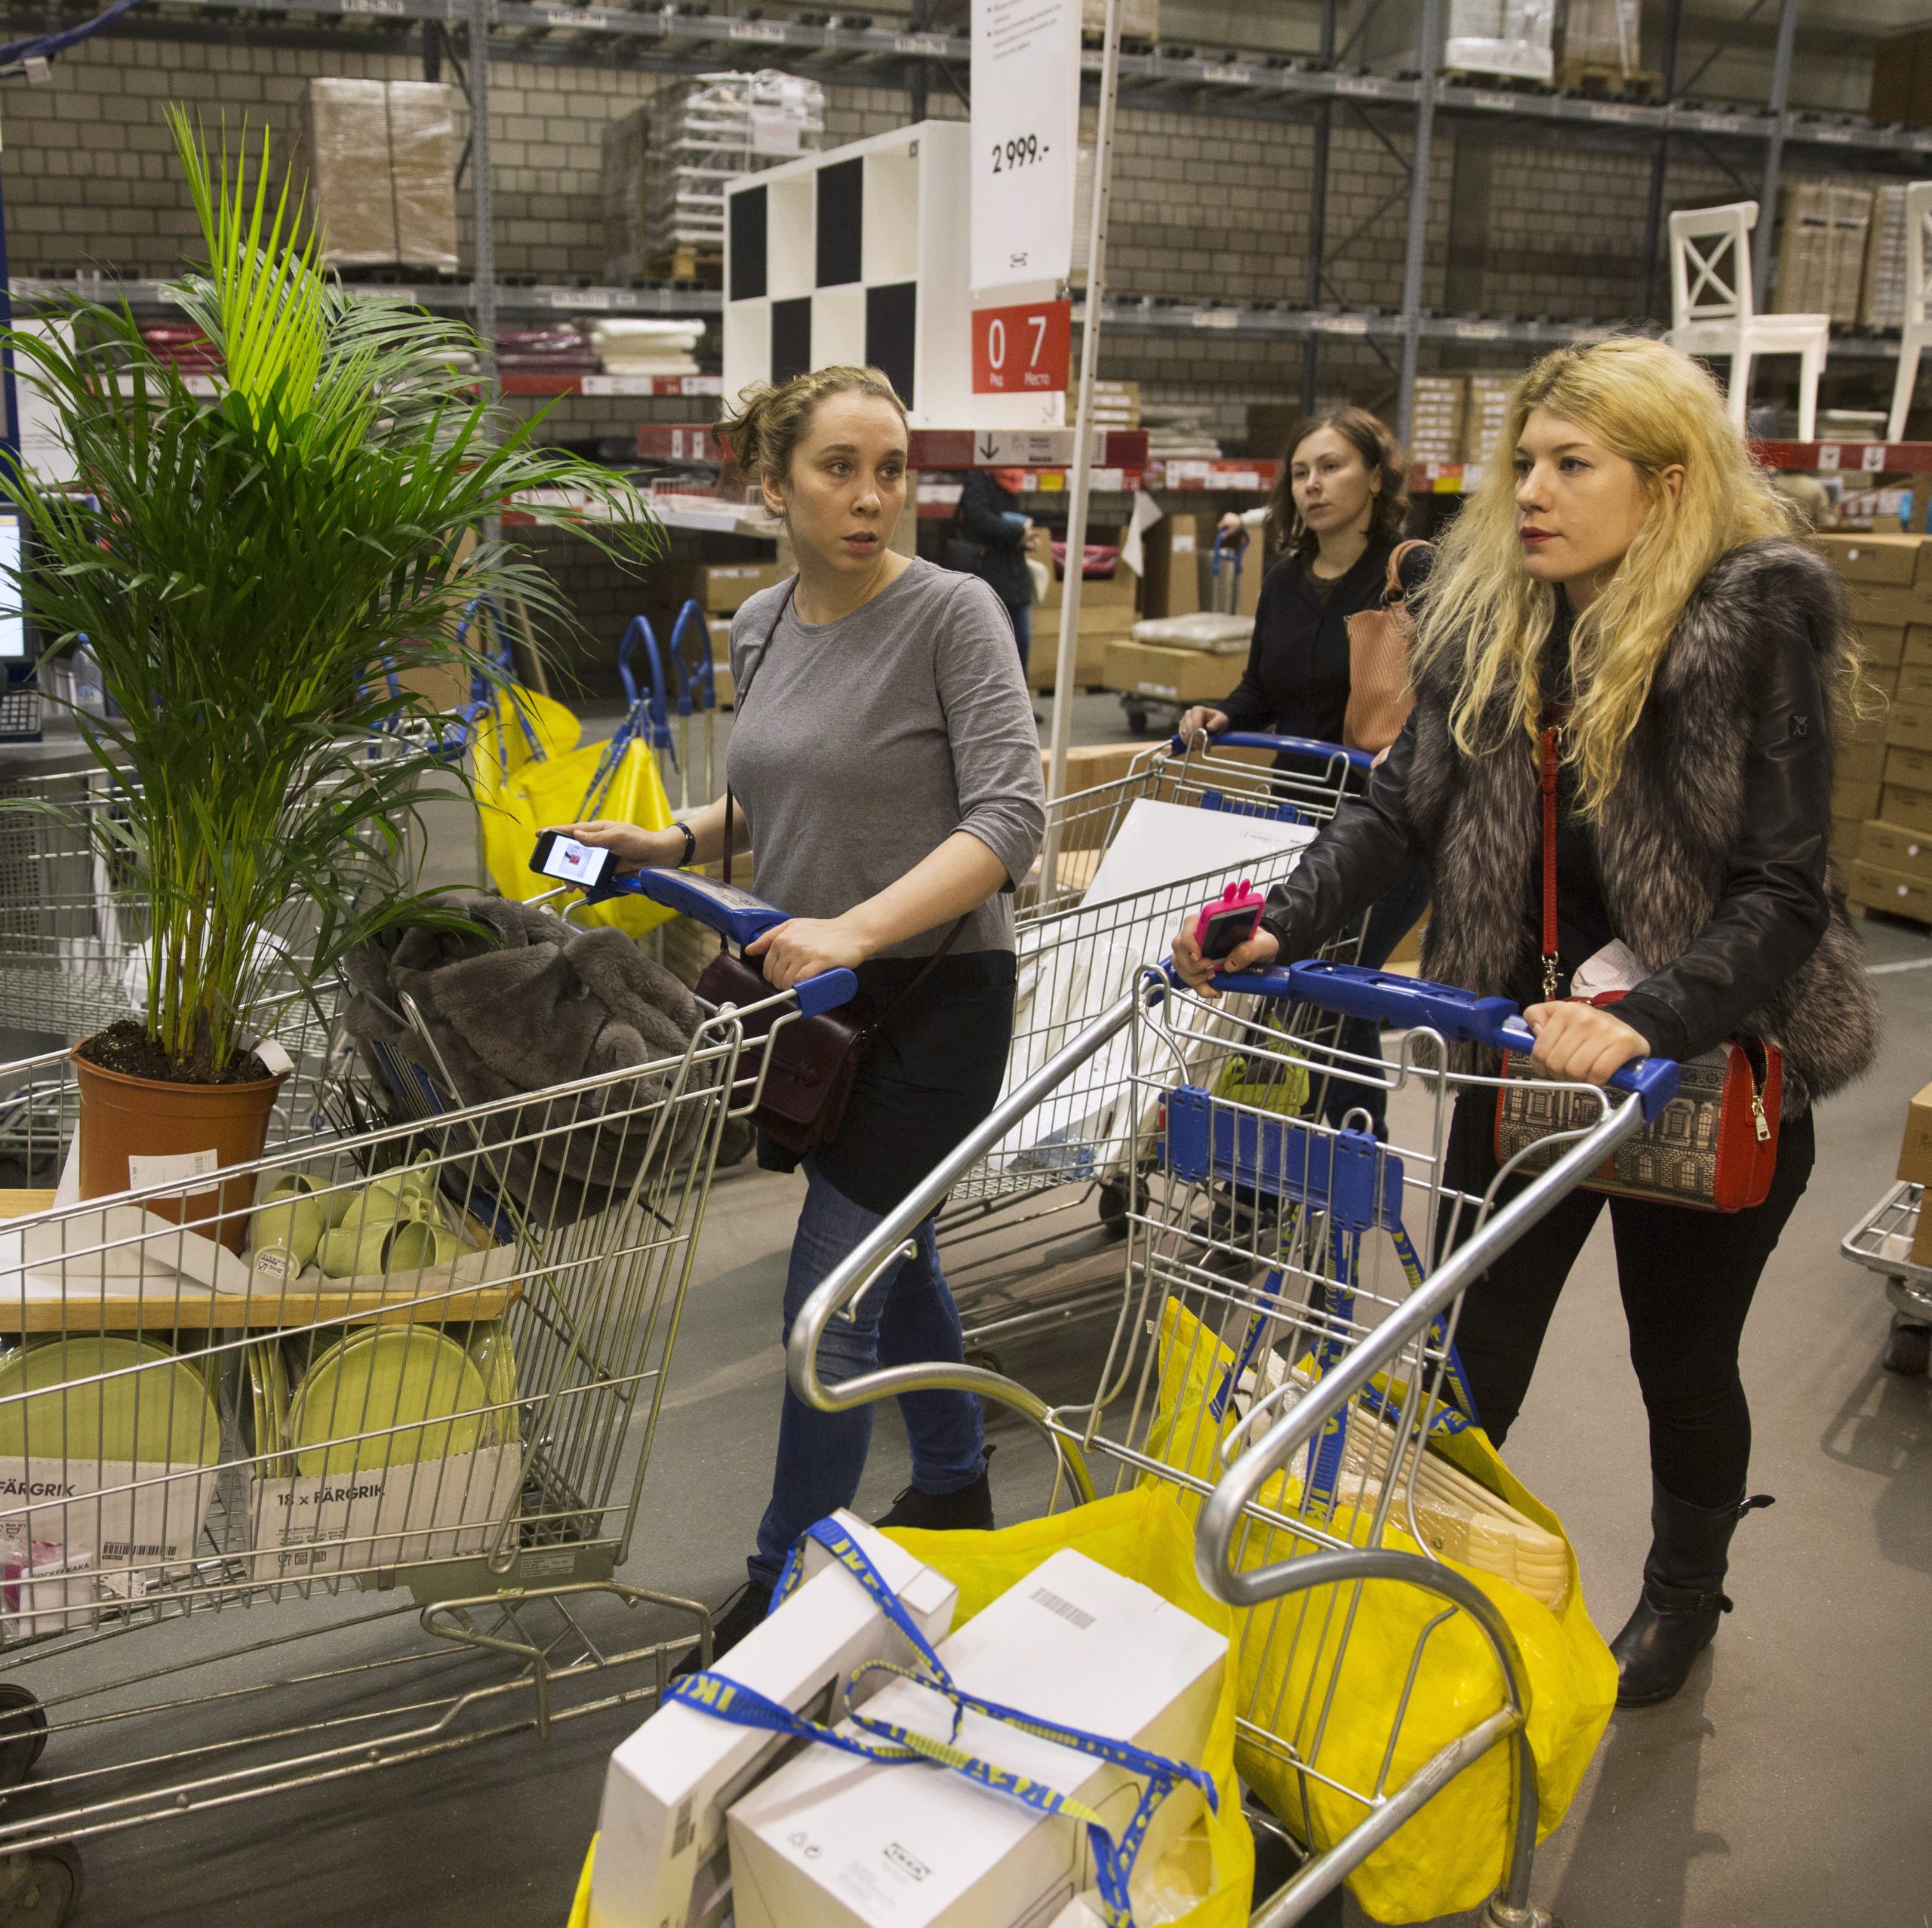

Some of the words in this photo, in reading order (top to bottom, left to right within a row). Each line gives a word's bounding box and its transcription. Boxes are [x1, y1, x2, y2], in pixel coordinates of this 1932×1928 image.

[992, 143, 1002, 174] 2
[1006, 133, 1051, 171] 999.-
[988, 318, 1006, 370] 0
[1027, 315, 1048, 367] 7
[277, 1493, 294, 1507] 18
[299, 1496, 309, 1505] x
[313, 1484, 386, 1505] FÄRGRIK
